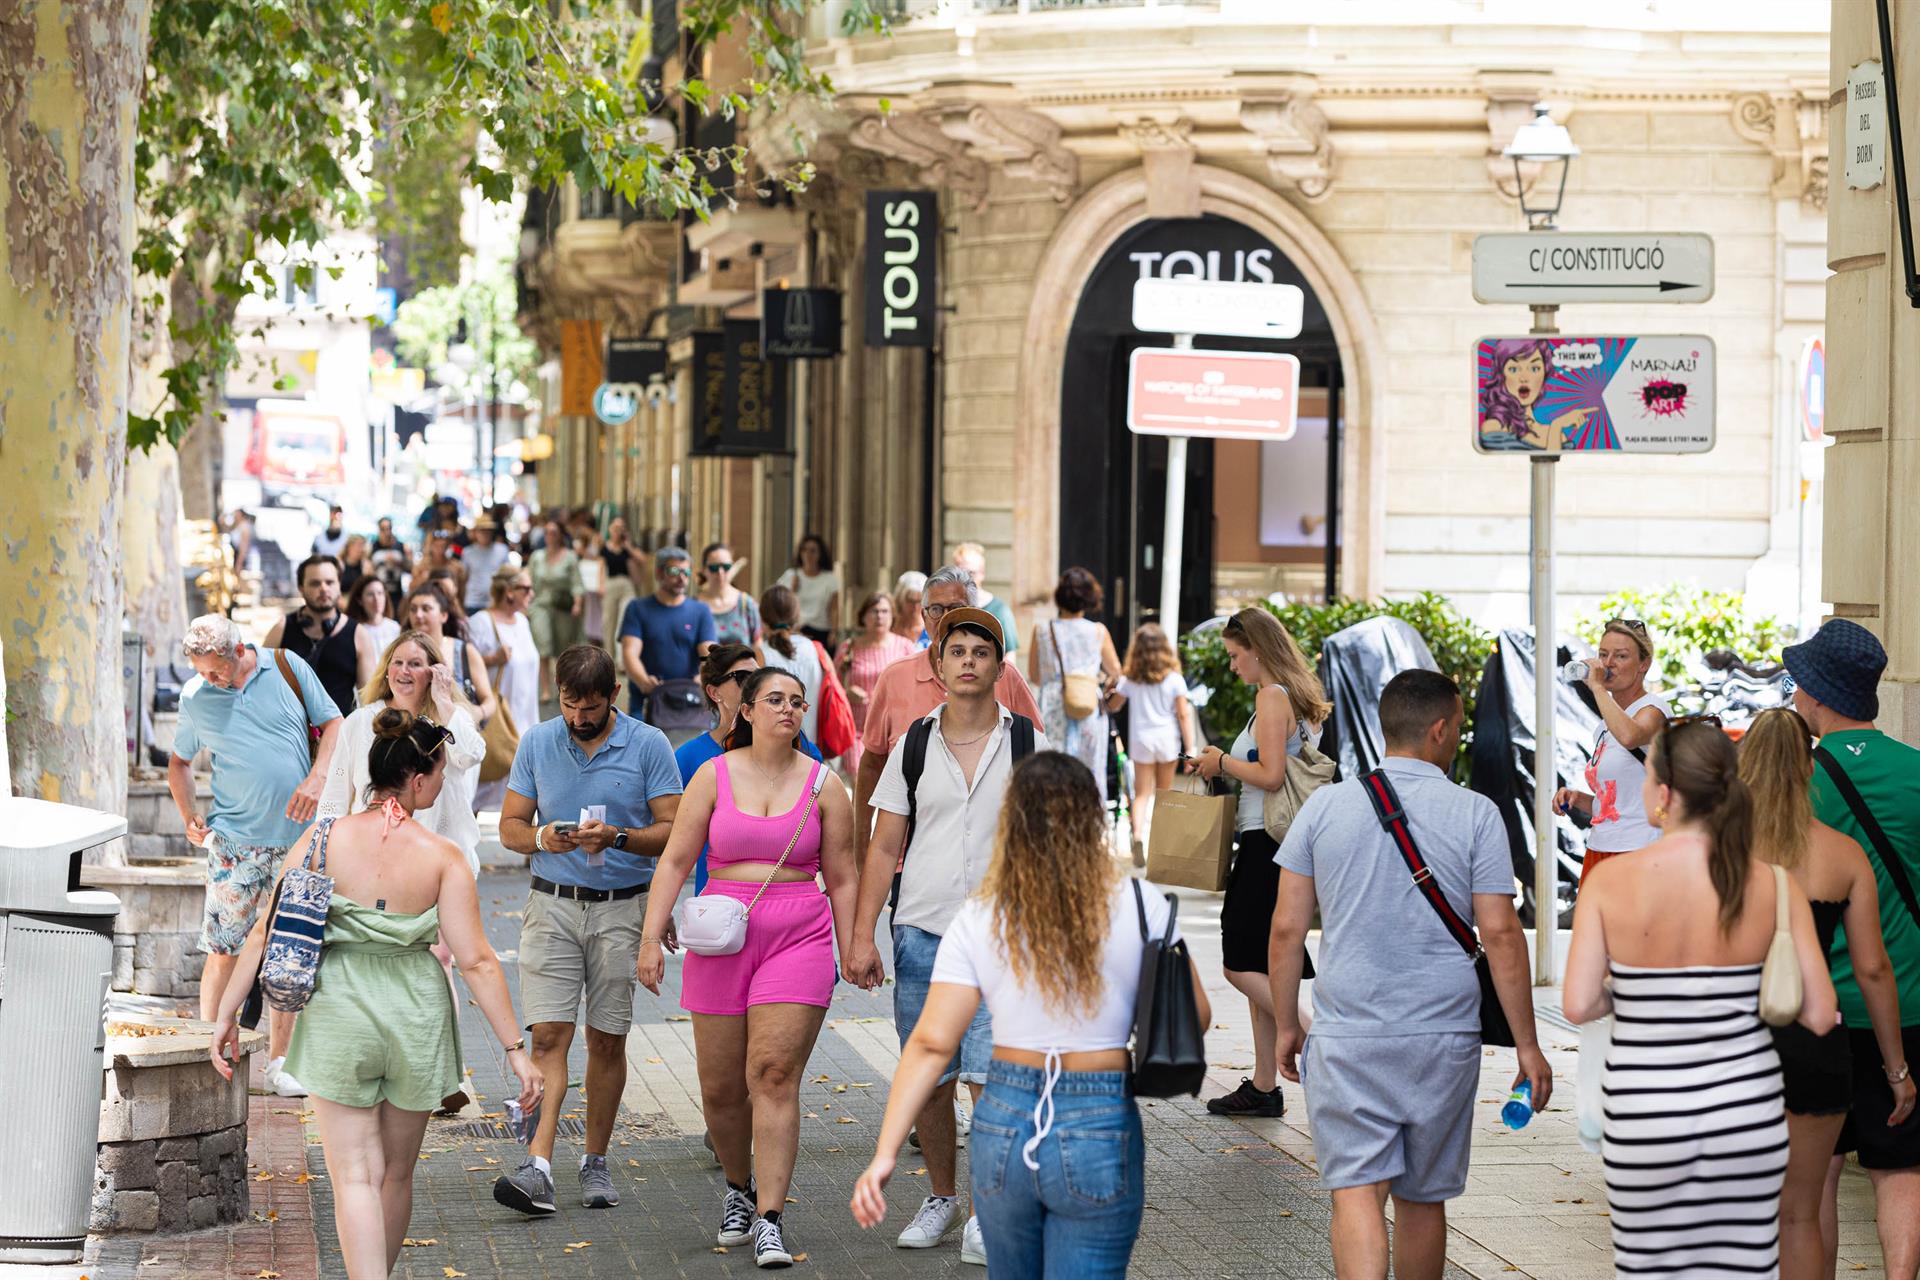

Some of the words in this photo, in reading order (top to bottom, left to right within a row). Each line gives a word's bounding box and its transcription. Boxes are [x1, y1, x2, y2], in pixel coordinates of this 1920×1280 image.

[1855, 81, 1877, 101] PASSEIG
[1859, 114, 1871, 131] DEL
[1856, 144, 1874, 164] BORN
[1529, 247, 1547, 273] C/
[1551, 240, 1664, 271] CONSTITUCIÓ
[883, 200, 920, 339] TOUS
[1558, 352, 1576, 361] THIS
[1579, 352, 1597, 360] WAY
[737, 361, 761, 432] BORN
[1650, 397, 1677, 410] ART
